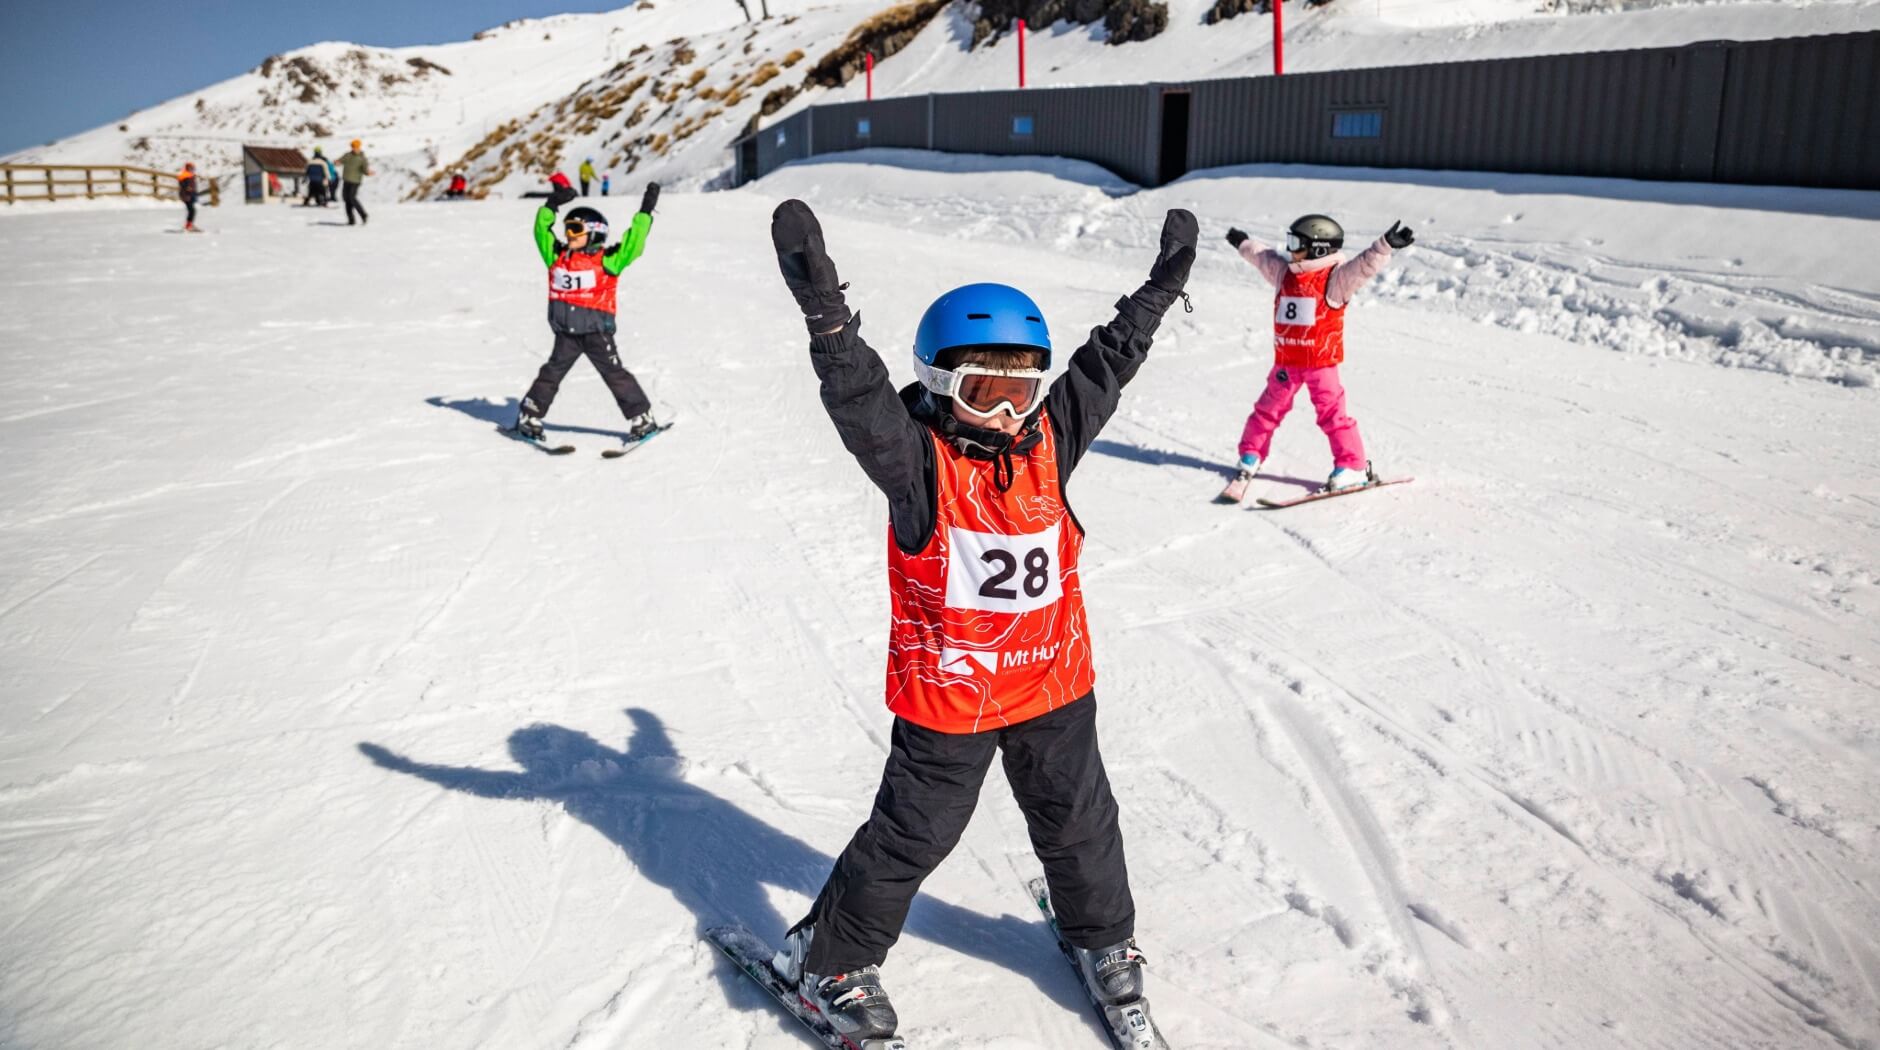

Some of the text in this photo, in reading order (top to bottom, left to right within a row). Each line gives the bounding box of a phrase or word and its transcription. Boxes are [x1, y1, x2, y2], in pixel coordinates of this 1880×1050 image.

[561, 274, 581, 289] 31
[1285, 301, 1297, 320] 8
[978, 547, 1050, 600] 28
[1002, 650, 1029, 668] Mt
